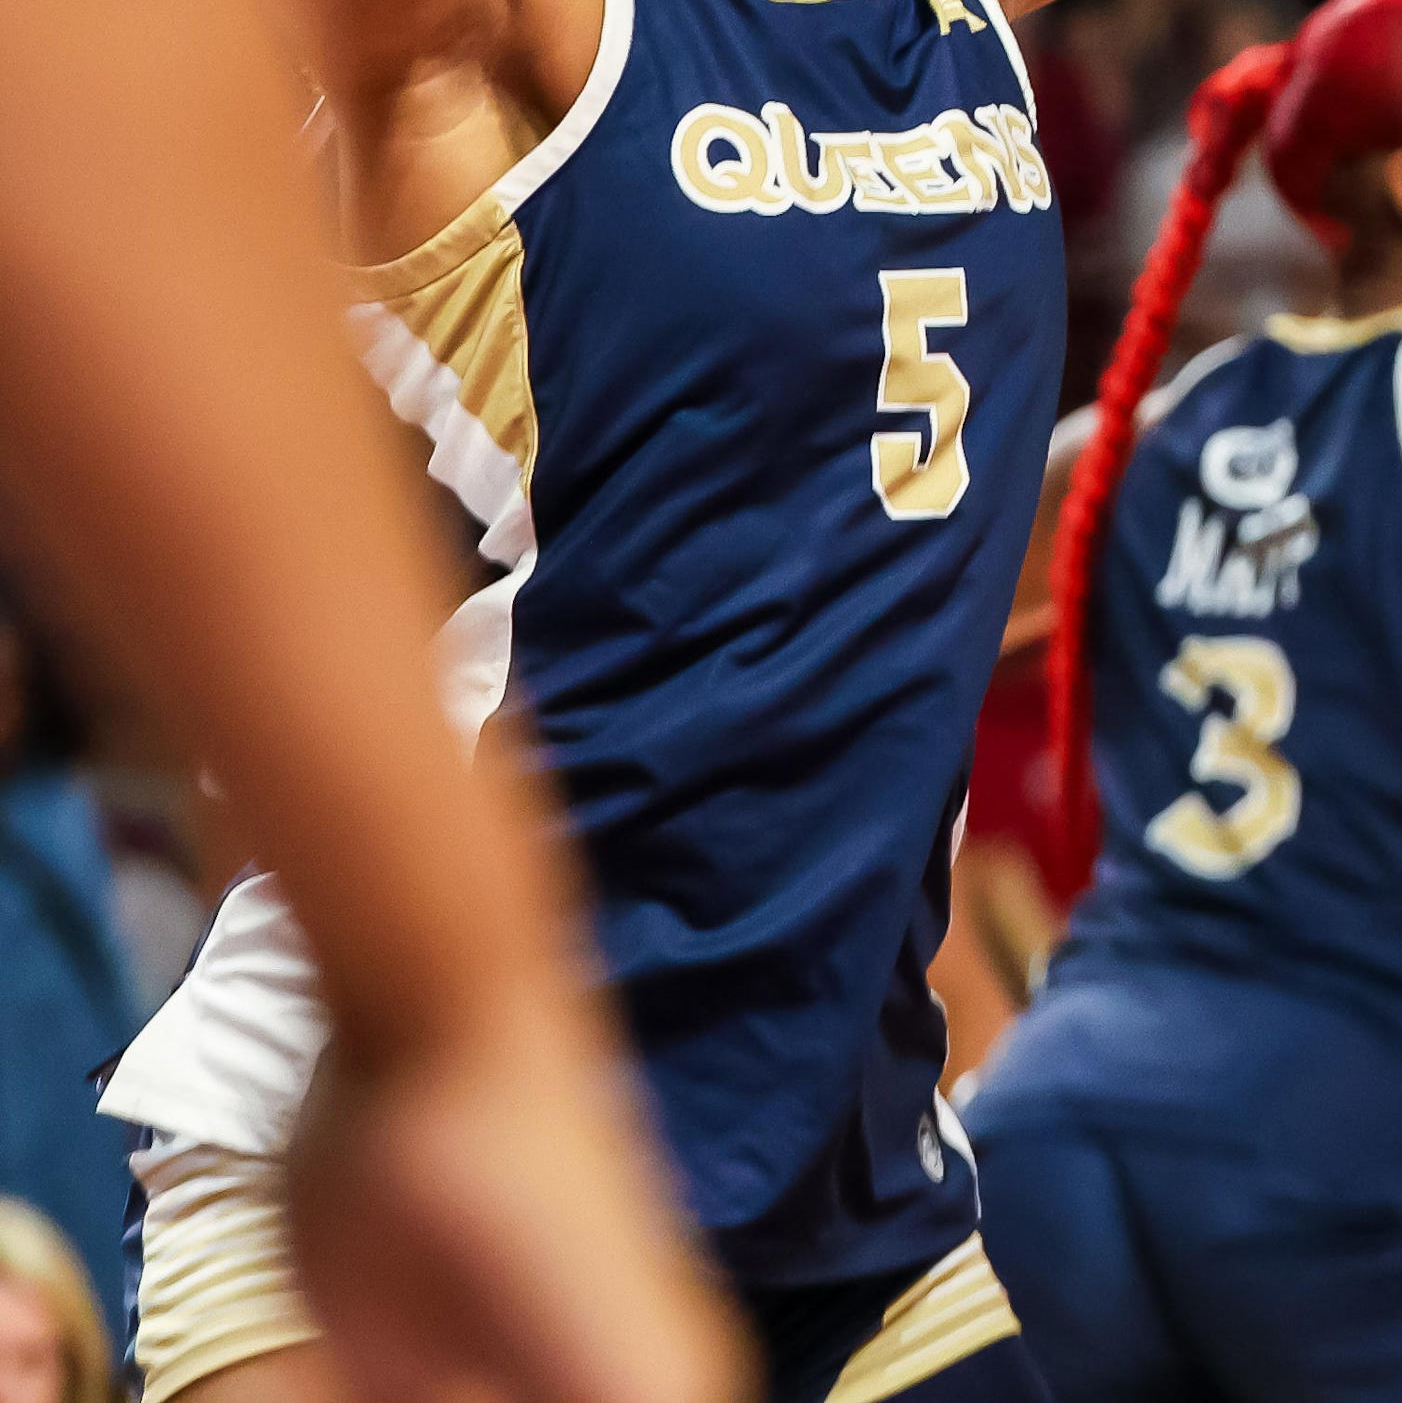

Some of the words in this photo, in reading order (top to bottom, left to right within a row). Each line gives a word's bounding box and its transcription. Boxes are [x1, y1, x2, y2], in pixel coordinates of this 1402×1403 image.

[671, 101, 1052, 216] QUEENS
[871, 266, 970, 521] 5
[1143, 634, 1303, 884] 3
